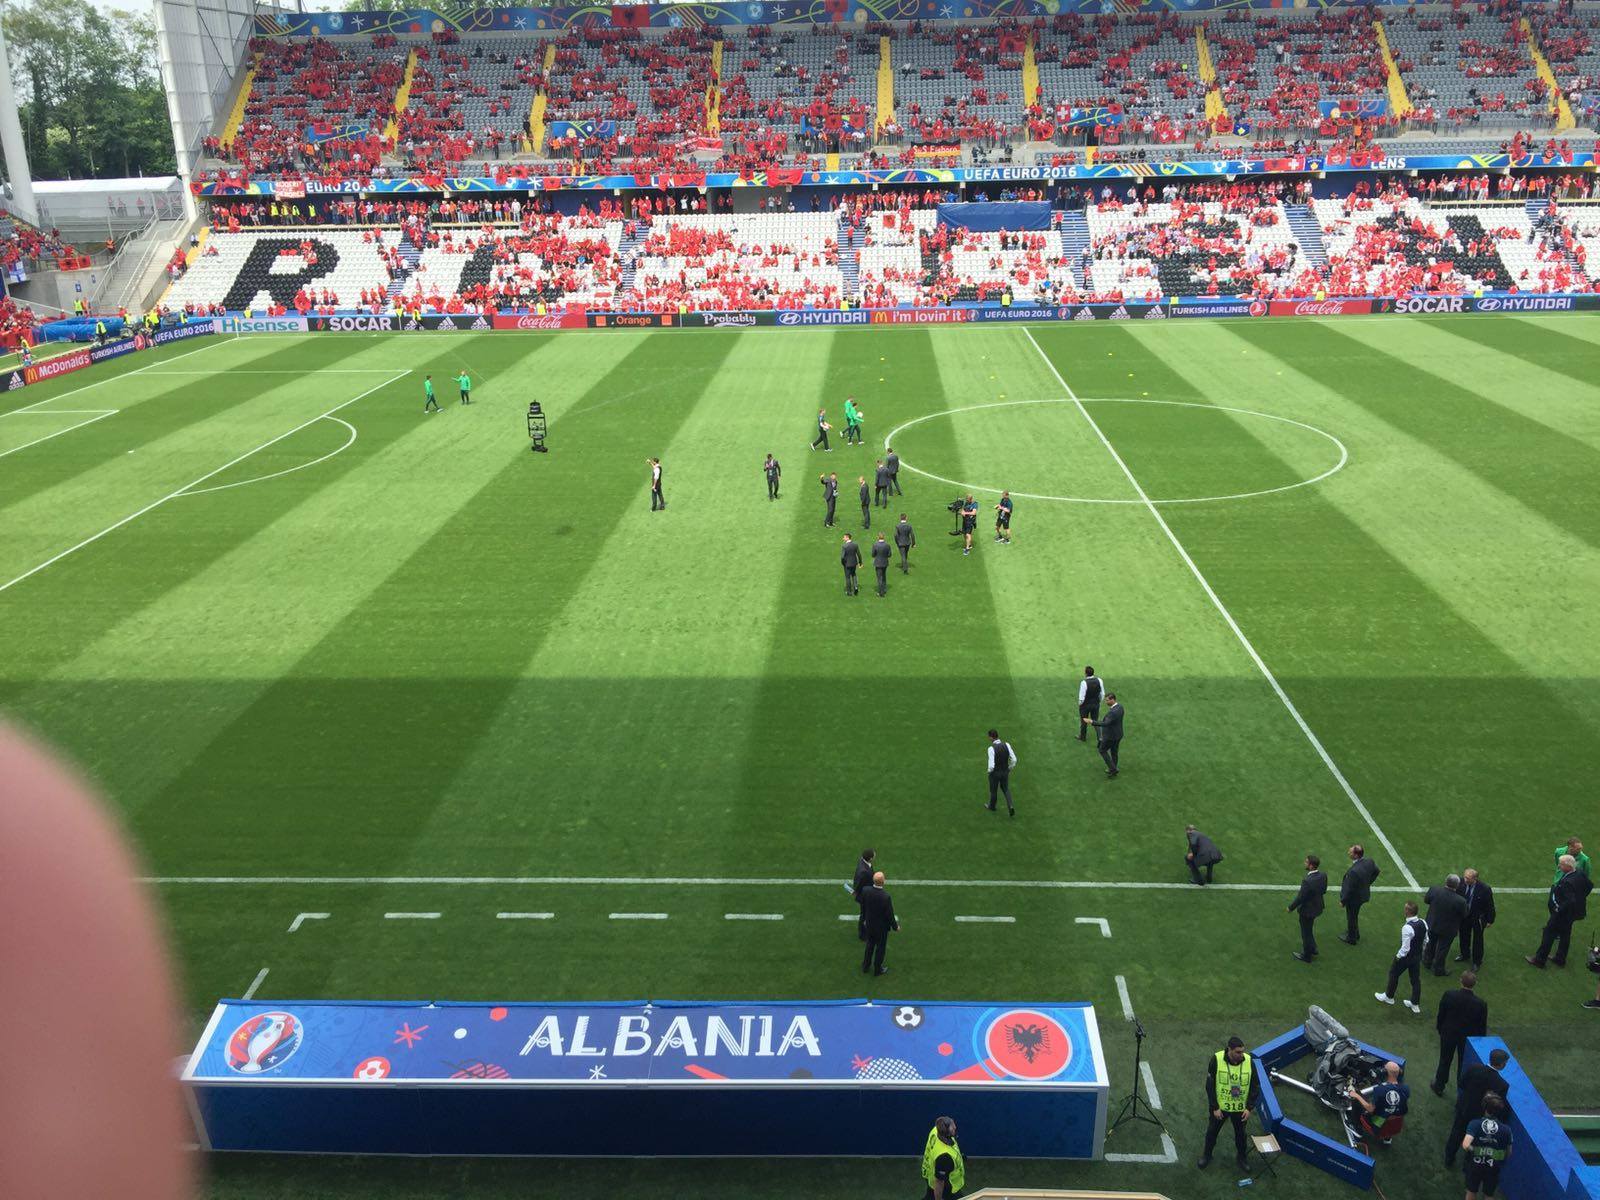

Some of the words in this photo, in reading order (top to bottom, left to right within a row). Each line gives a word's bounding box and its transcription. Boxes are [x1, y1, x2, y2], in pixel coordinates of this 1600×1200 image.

[964, 170, 1000, 180] UEFA
[1003, 168, 1040, 178] EURO
[1043, 167, 1077, 177] 2016
[1394, 298, 1464, 313] SOCAR
[1503, 298, 1571, 309] HYUNDAI
[893, 311, 911, 322] i'm
[1172, 307, 1209, 315] TURKISH
[616, 316, 652, 328] Orange
[702, 313, 756, 325] Probably
[803, 312, 867, 323] HYUNDAI
[221, 319, 300, 331] Hisense
[330, 318, 392, 330] SOCAR
[155, 331, 174, 343] UEFA
[174, 327, 194, 338] EURO
[194, 323, 214, 335] 2016
[38, 354, 90, 377] McDonald's
[519, 1014, 822, 1057] ALBANIA
